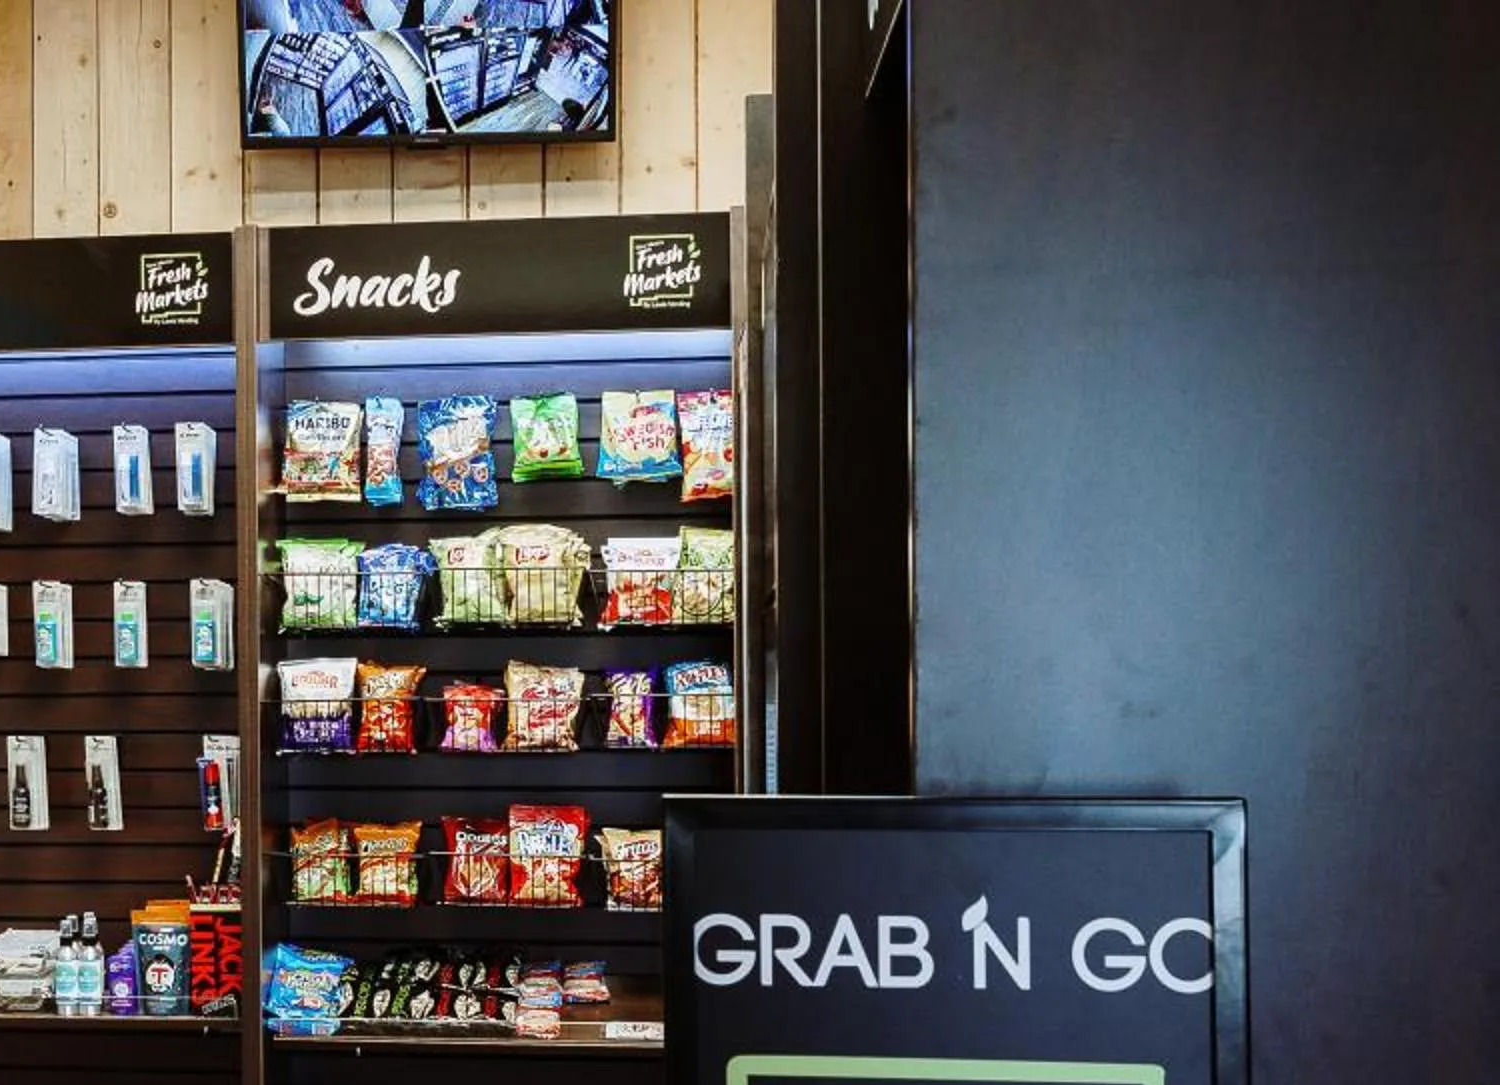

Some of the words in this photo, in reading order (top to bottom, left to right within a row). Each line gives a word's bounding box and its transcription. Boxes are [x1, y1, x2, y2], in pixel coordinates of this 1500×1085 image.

[636, 243, 683, 272] Fresh
[147, 262, 191, 290] Fresh
[293, 255, 462, 316] Snacks
[623, 260, 701, 296] Markets
[135, 278, 209, 314] Markets
[138, 933, 189, 947] COSMO
[694, 913, 935, 989] GRAB
